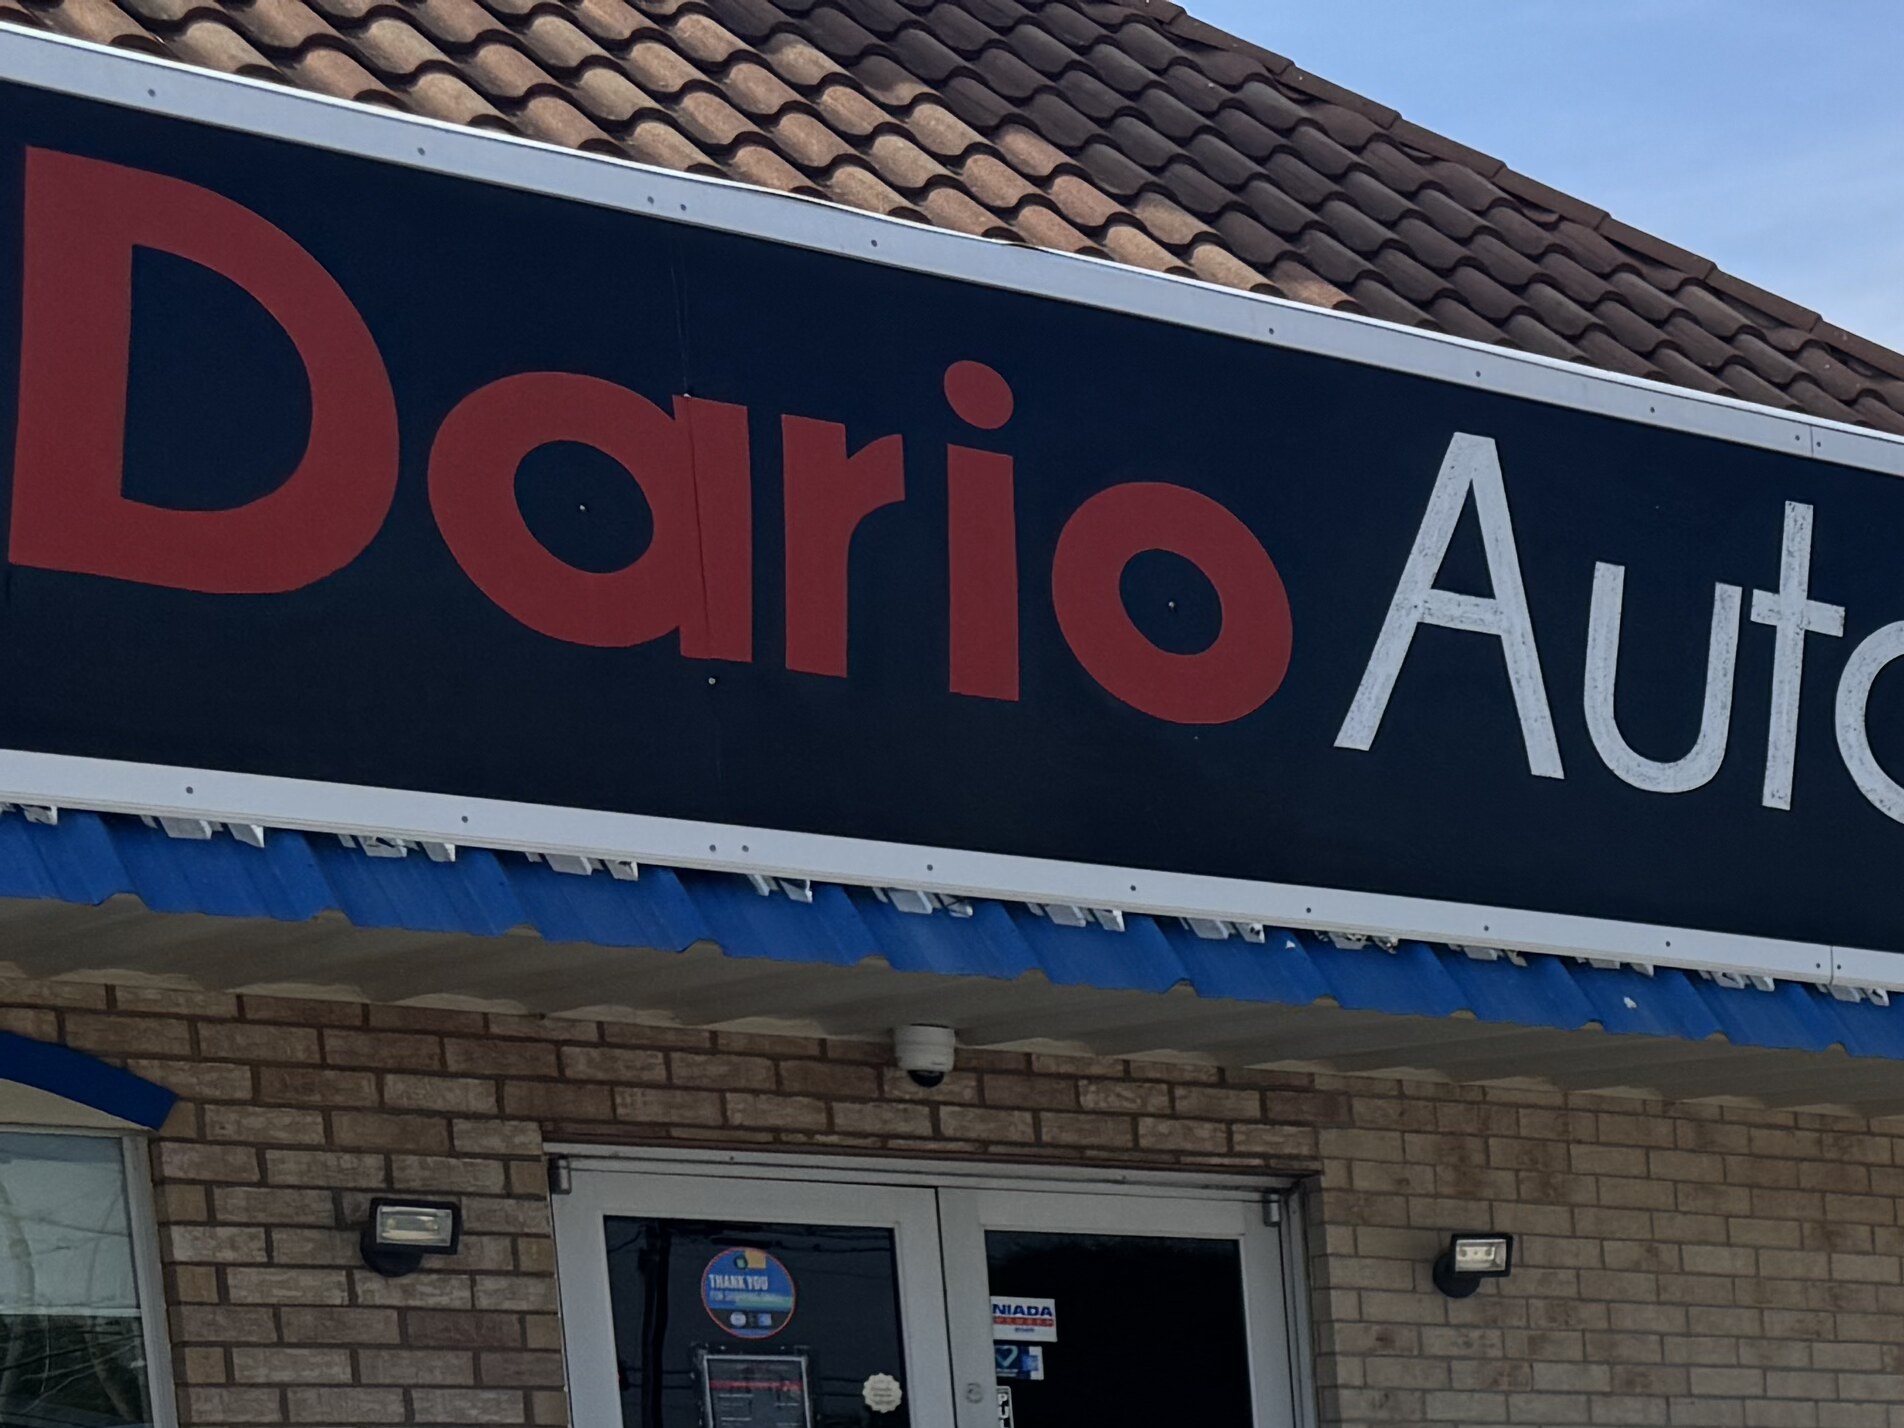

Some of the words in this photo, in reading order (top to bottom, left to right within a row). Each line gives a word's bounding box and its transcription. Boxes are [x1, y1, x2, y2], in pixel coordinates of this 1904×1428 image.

[9, 145, 1293, 725] Dario
[709, 1273, 747, 1290] THANK
[747, 1275, 769, 1291] YOU
[991, 1303, 1053, 1317] NIADA
